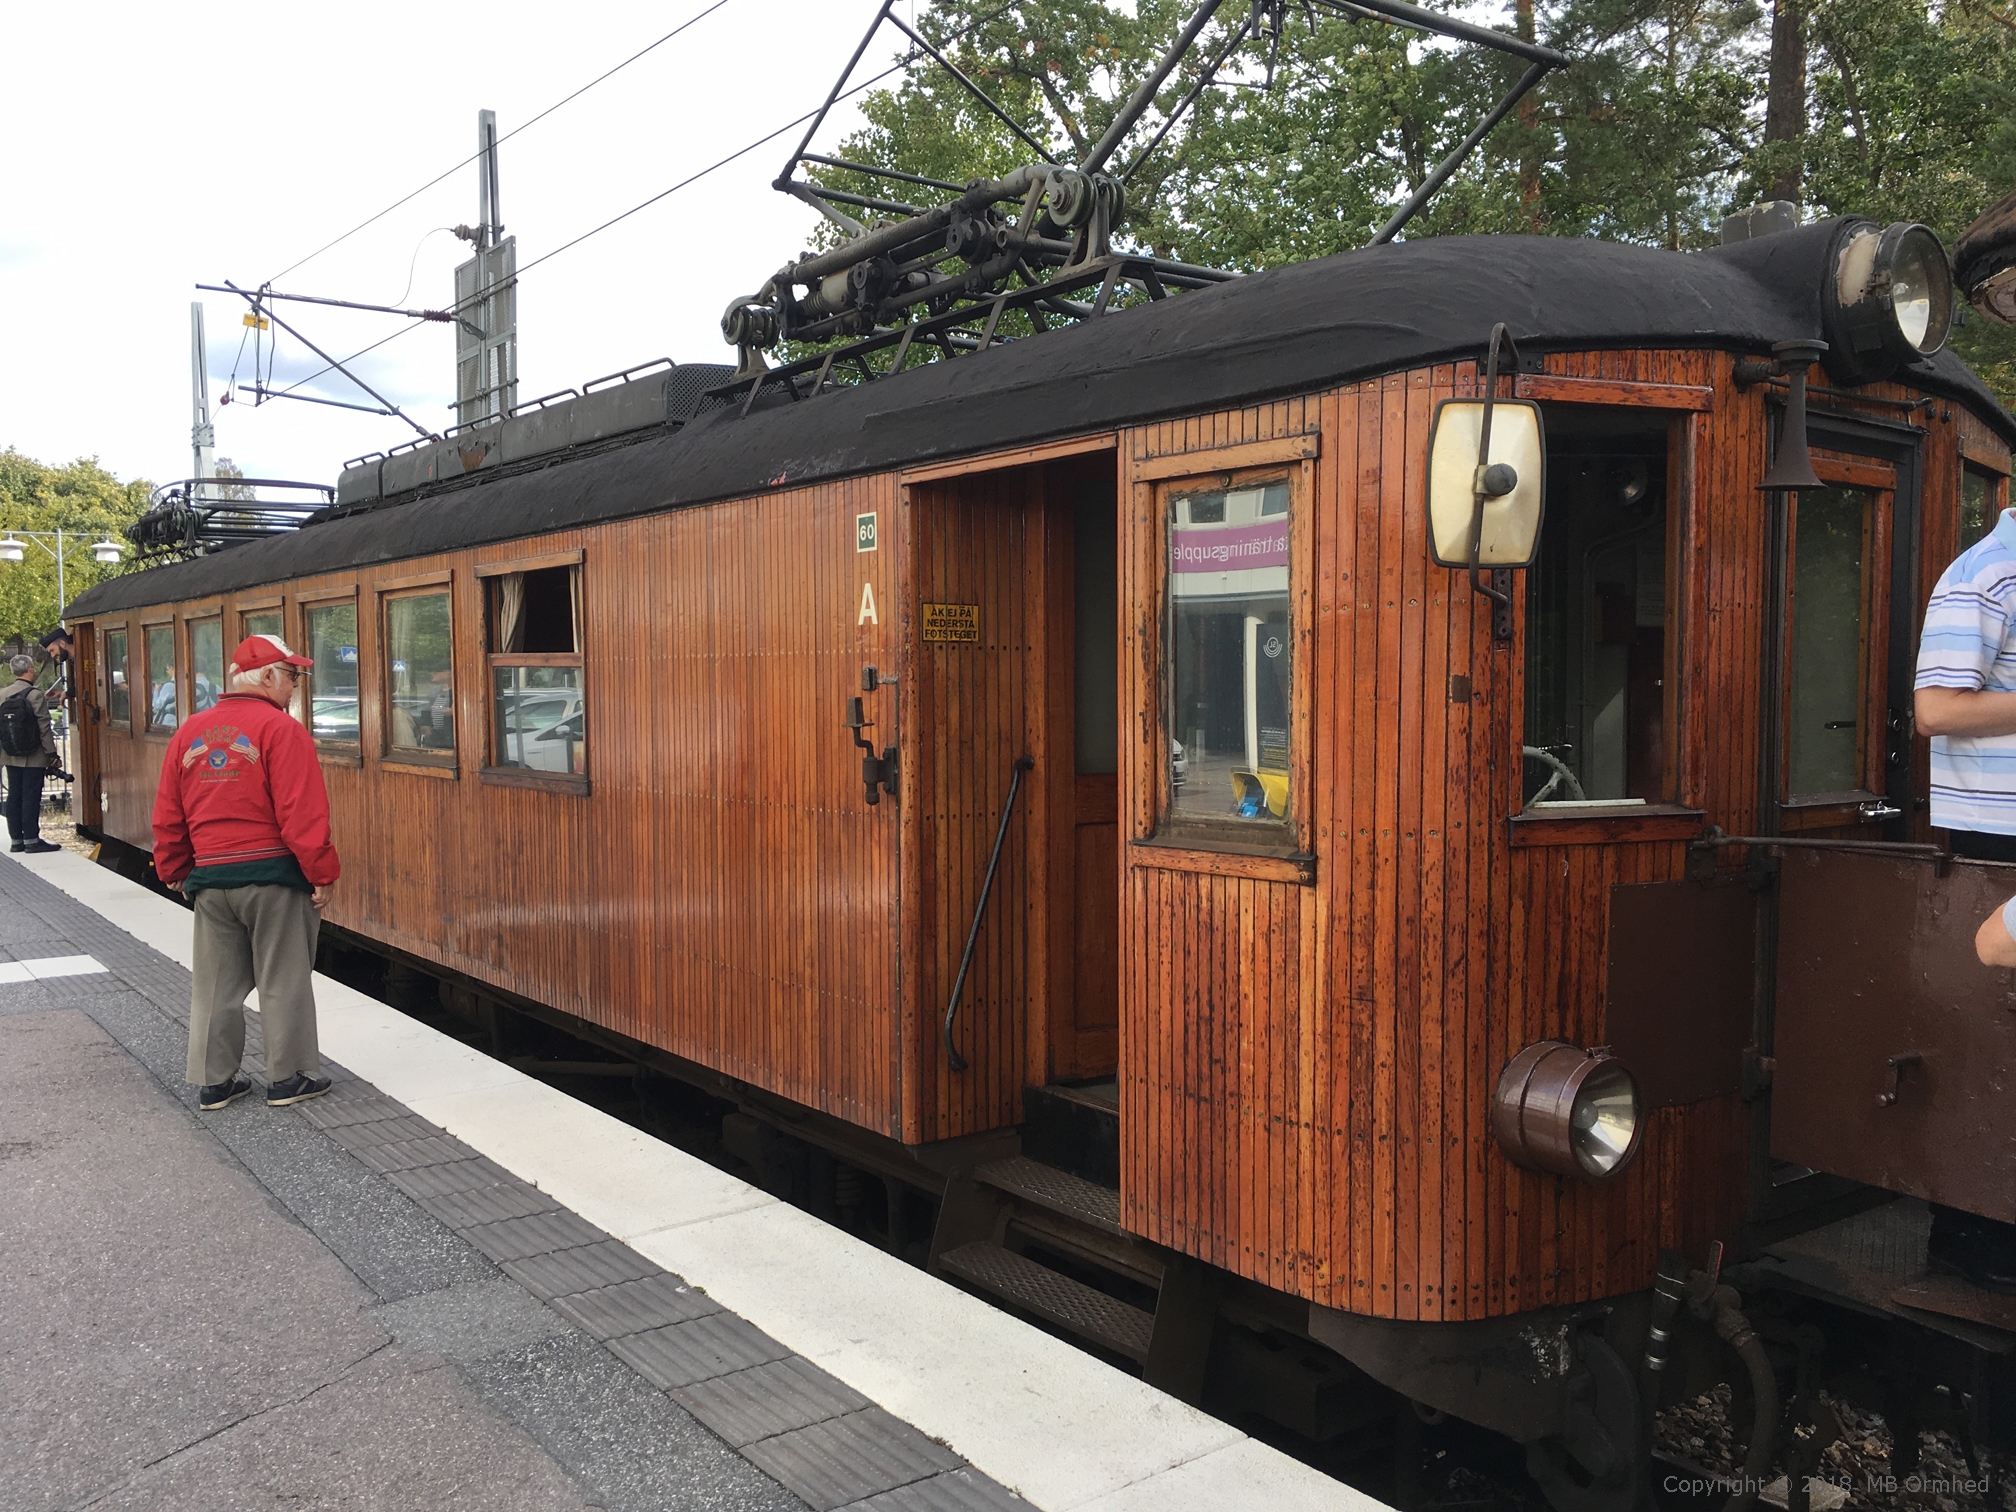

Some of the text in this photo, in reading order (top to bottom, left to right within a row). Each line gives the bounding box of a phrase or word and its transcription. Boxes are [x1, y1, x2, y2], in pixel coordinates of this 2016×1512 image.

[860, 523, 874, 541] 60
[858, 582, 878, 625] A
[947, 608, 957, 618] EJ
[927, 618, 975, 628] NEDERSTA
[925, 629, 978, 639] FOTSTEGET
[204, 726, 238, 737] GANT
[207, 734, 231, 743] USA
